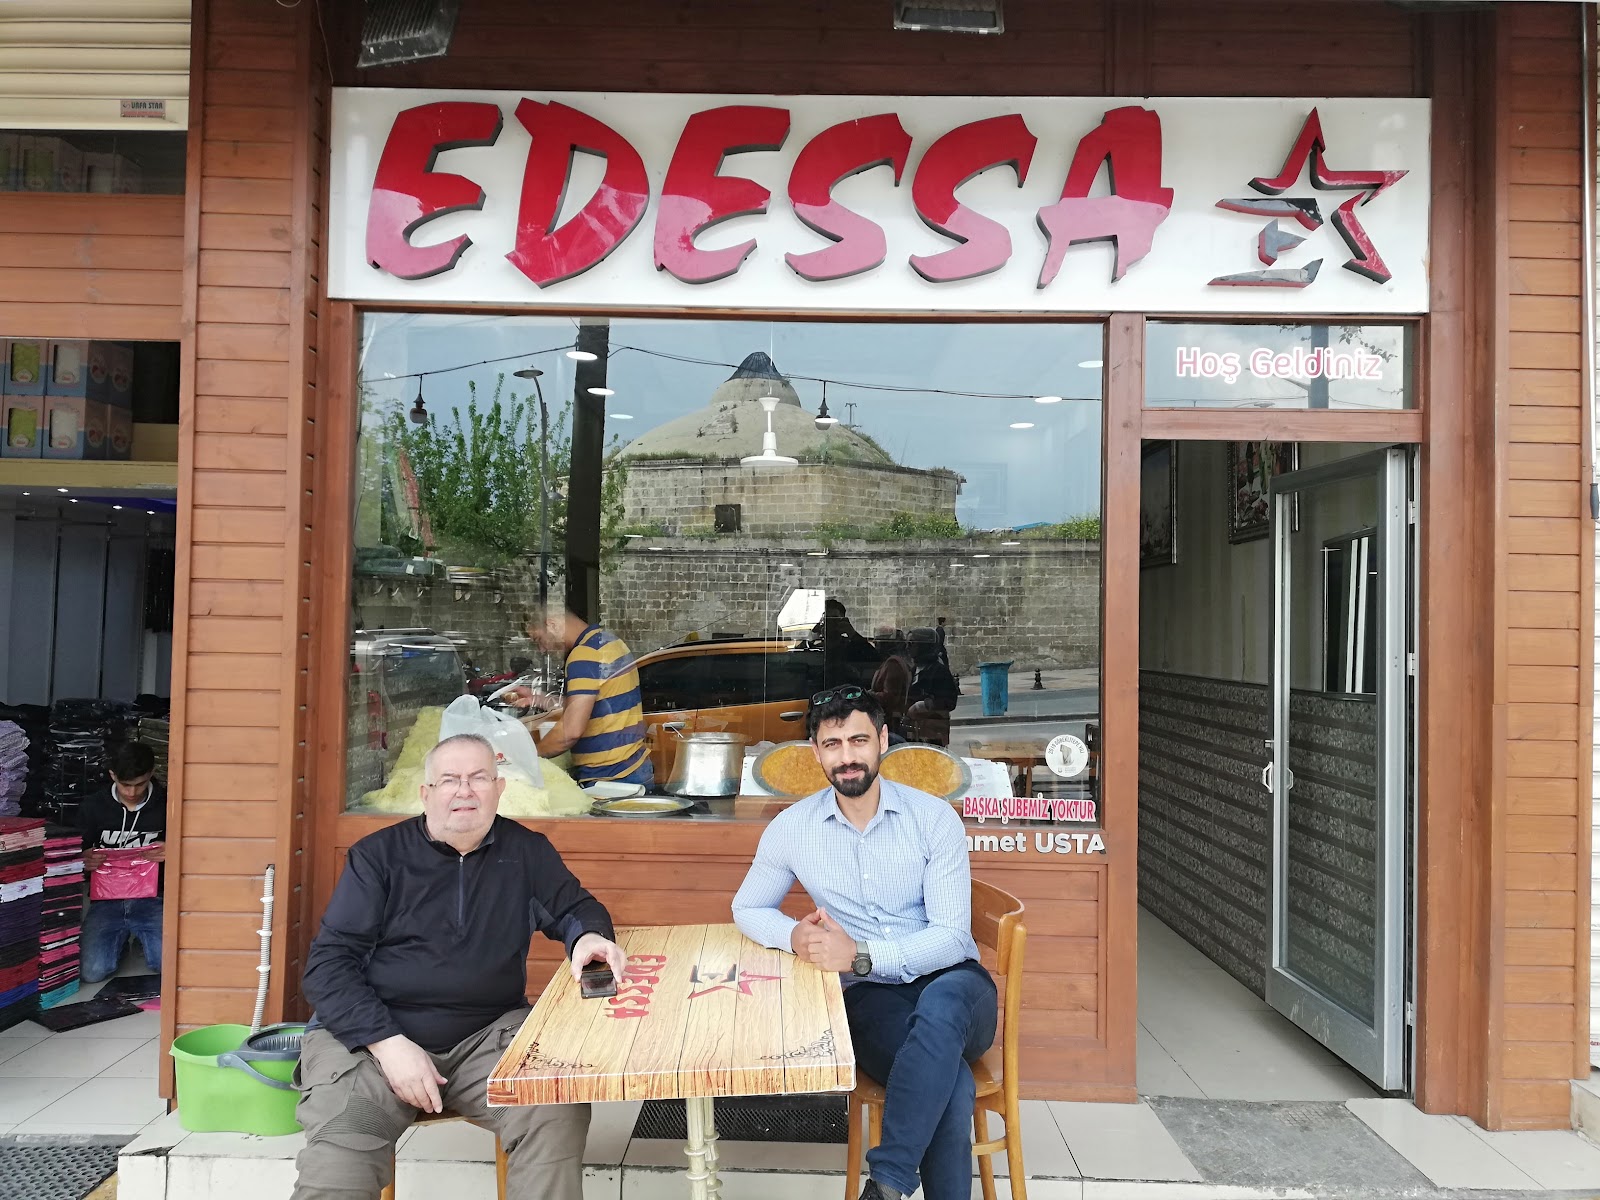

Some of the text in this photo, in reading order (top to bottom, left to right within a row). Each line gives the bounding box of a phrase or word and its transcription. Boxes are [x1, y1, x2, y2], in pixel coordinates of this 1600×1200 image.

[366, 97, 1174, 289] EDESSA
[1177, 347, 1382, 383] Hoş Geldiniz
[964, 794, 1095, 822] BAŞKA ŞUBEMİZ YOKTUR
[1035, 832, 1105, 854] USTA
[603, 954, 667, 1019] EDESSA
